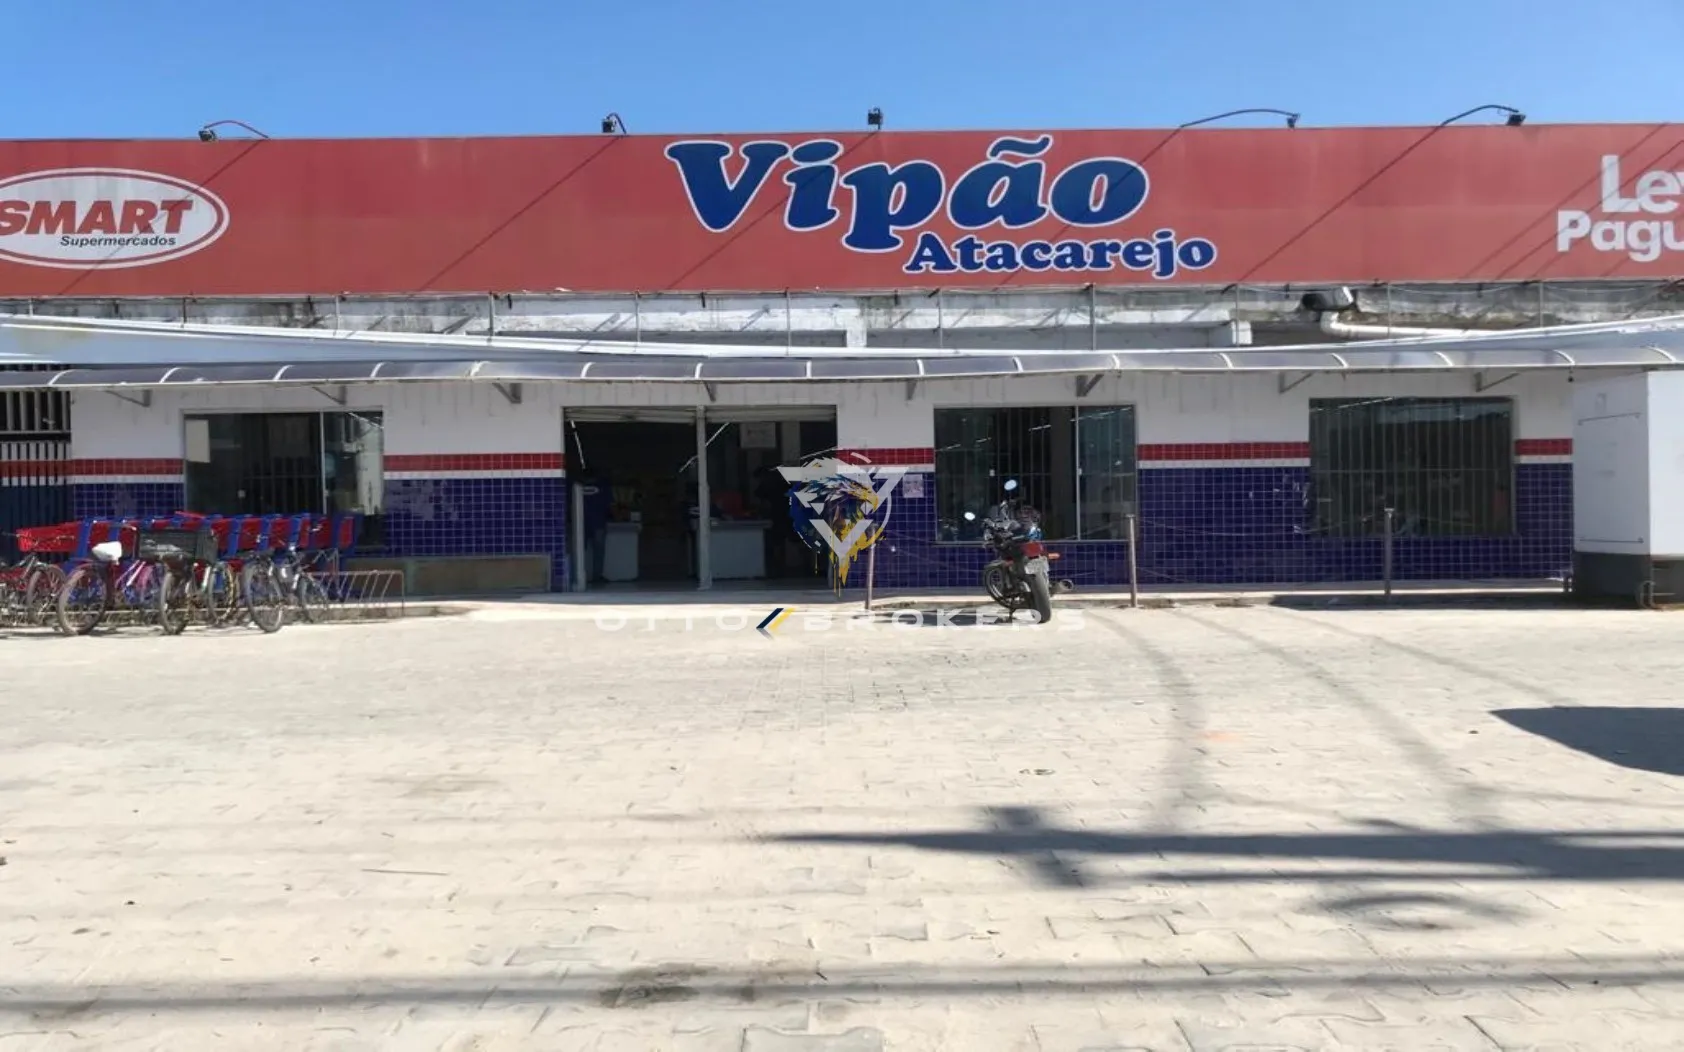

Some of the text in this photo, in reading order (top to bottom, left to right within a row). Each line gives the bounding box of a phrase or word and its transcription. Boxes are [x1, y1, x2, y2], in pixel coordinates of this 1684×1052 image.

[665, 134, 1150, 252] Vipão
[0, 199, 193, 235] SMART
[60, 235, 176, 248] Supermercados
[903, 230, 1217, 278] Atacarejo
